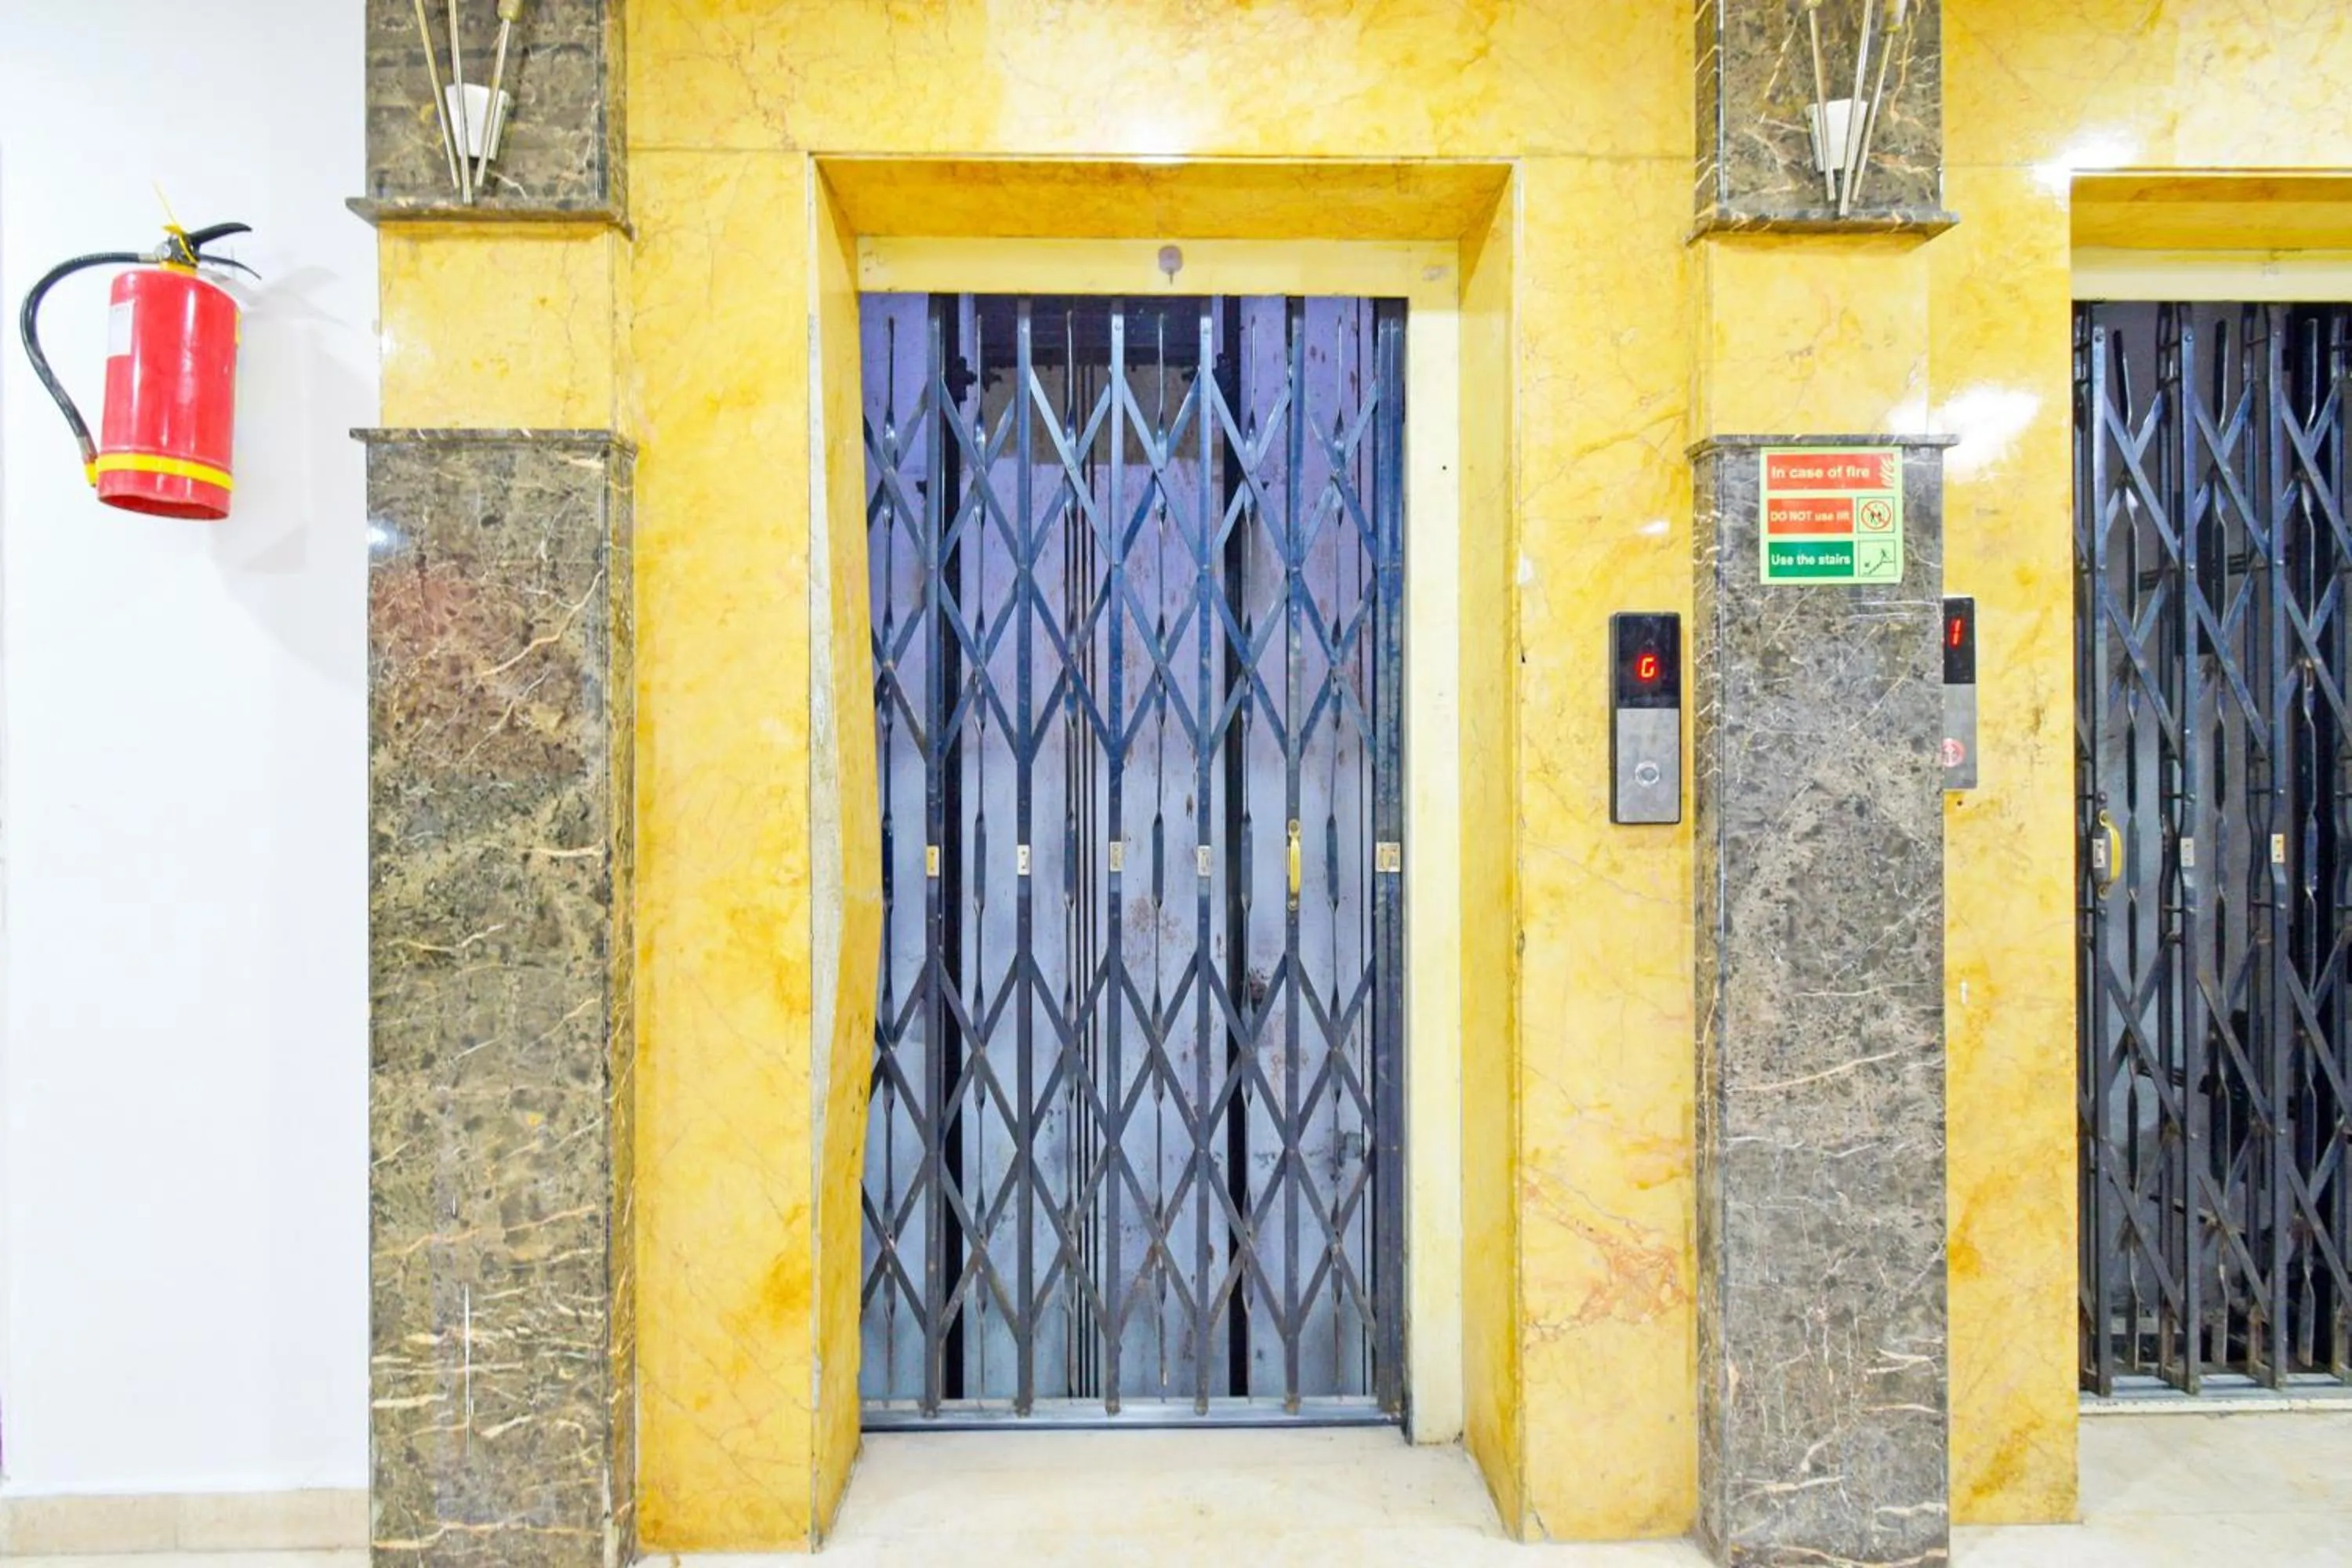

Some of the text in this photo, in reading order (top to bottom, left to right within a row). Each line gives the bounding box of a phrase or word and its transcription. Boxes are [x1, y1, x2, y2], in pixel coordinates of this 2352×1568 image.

[1771, 466, 1870, 478] In case of fire
[1770, 511, 1787, 521] DO
[1789, 510, 1812, 521] NOT
[1771, 554, 1850, 565] Use the stairs
